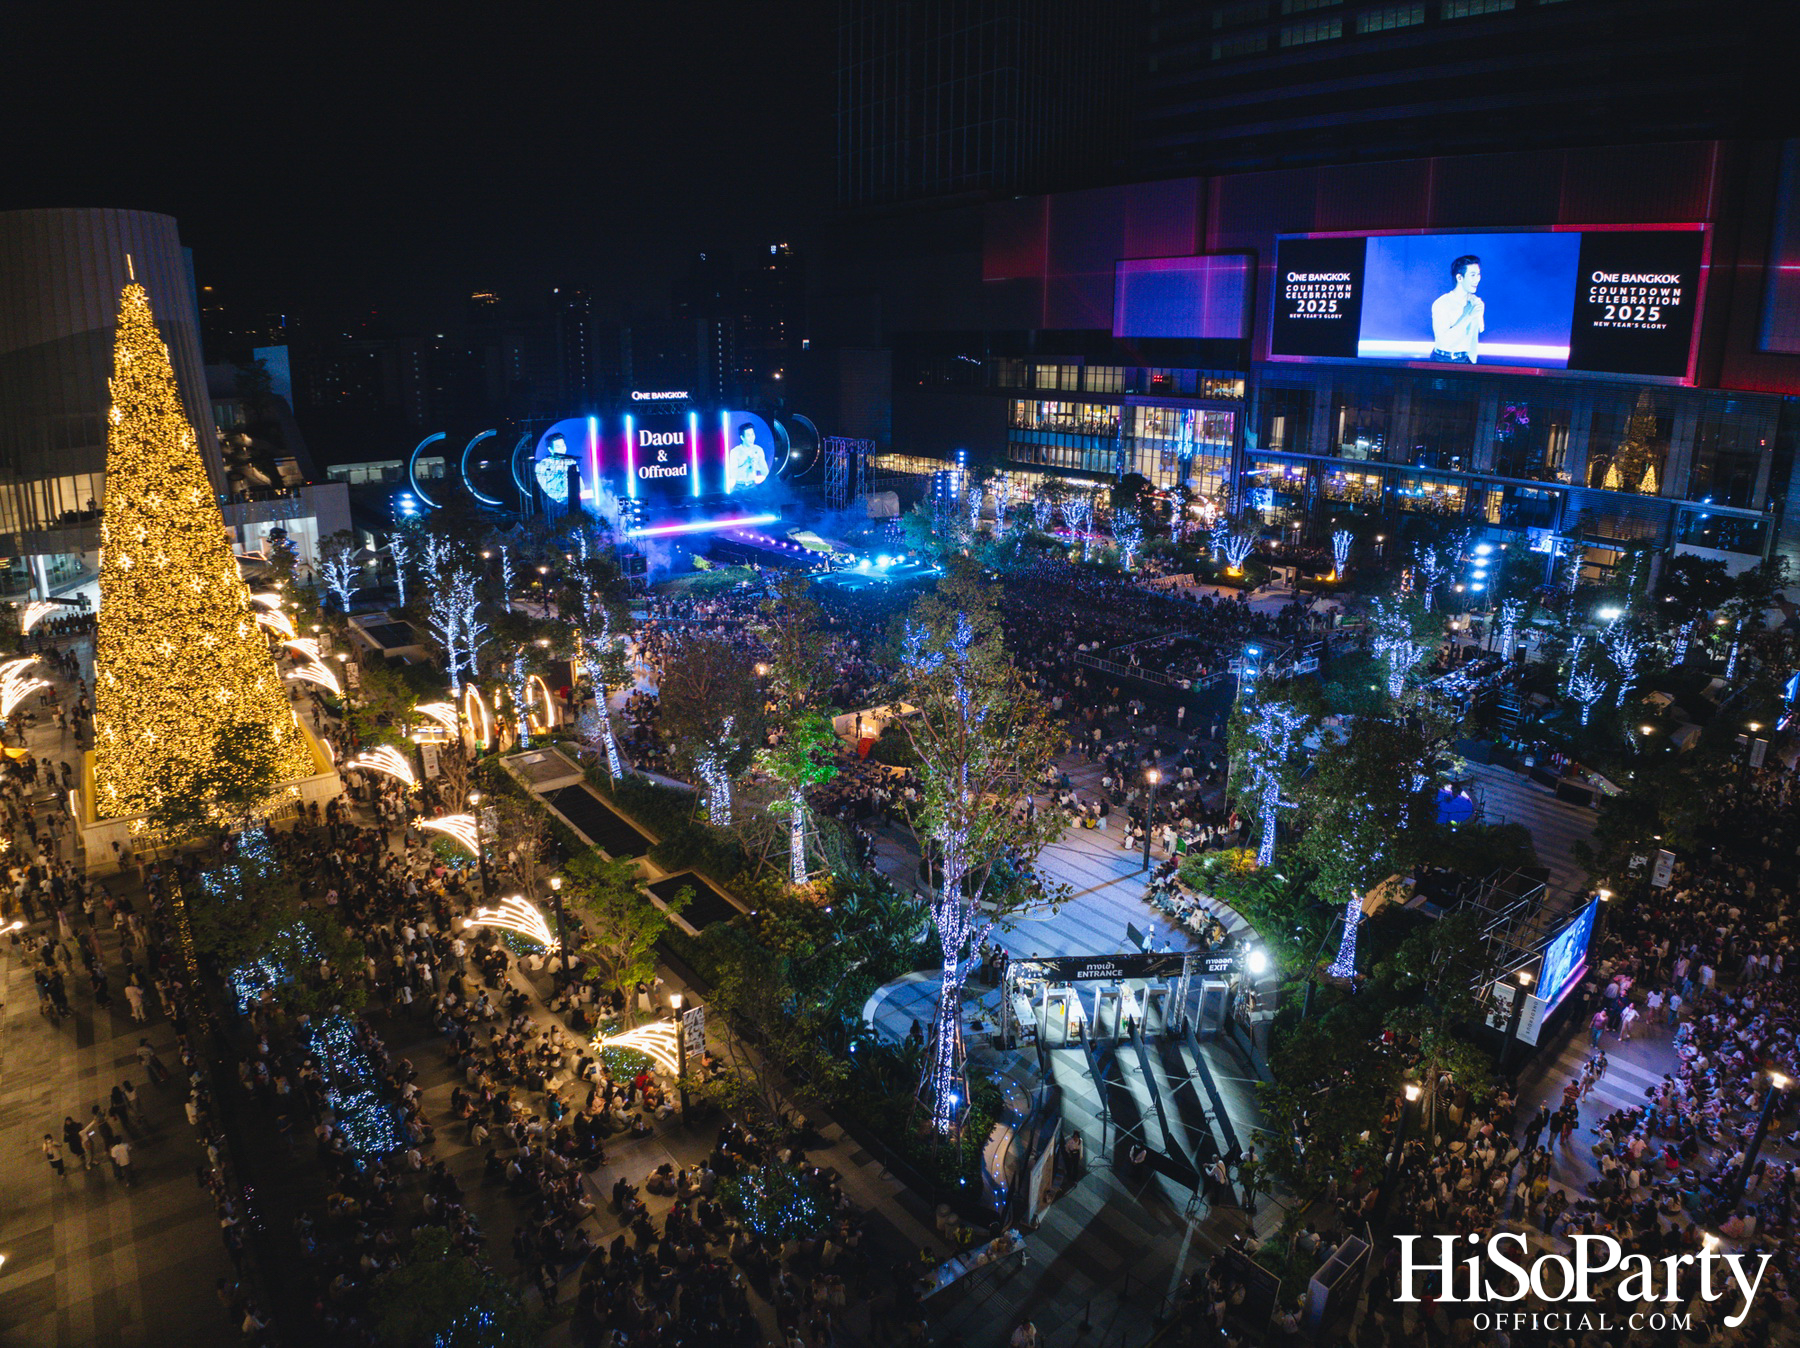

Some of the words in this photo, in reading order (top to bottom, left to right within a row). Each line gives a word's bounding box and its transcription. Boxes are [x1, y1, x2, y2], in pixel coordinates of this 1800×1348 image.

[1308, 272, 1350, 282] BANGKOK
[1621, 274, 1680, 284] BANGKOK
[1286, 284, 1352, 292] COUNTDOWN
[1590, 286, 1681, 296] COUNTDOWN
[1589, 295, 1680, 305] CELEBRATION
[1296, 299, 1337, 313] 2025
[1603, 305, 1660, 321] 2025
[651, 391, 688, 400] BANGKOK
[638, 429, 684, 447] Daou
[657, 449, 668, 462] &
[638, 463, 688, 479] Offroad
[1086, 961, 1115, 970] ทางเข้า
[1208, 964, 1229, 972] EXIT
[1077, 969, 1123, 978] ENTRANCE
